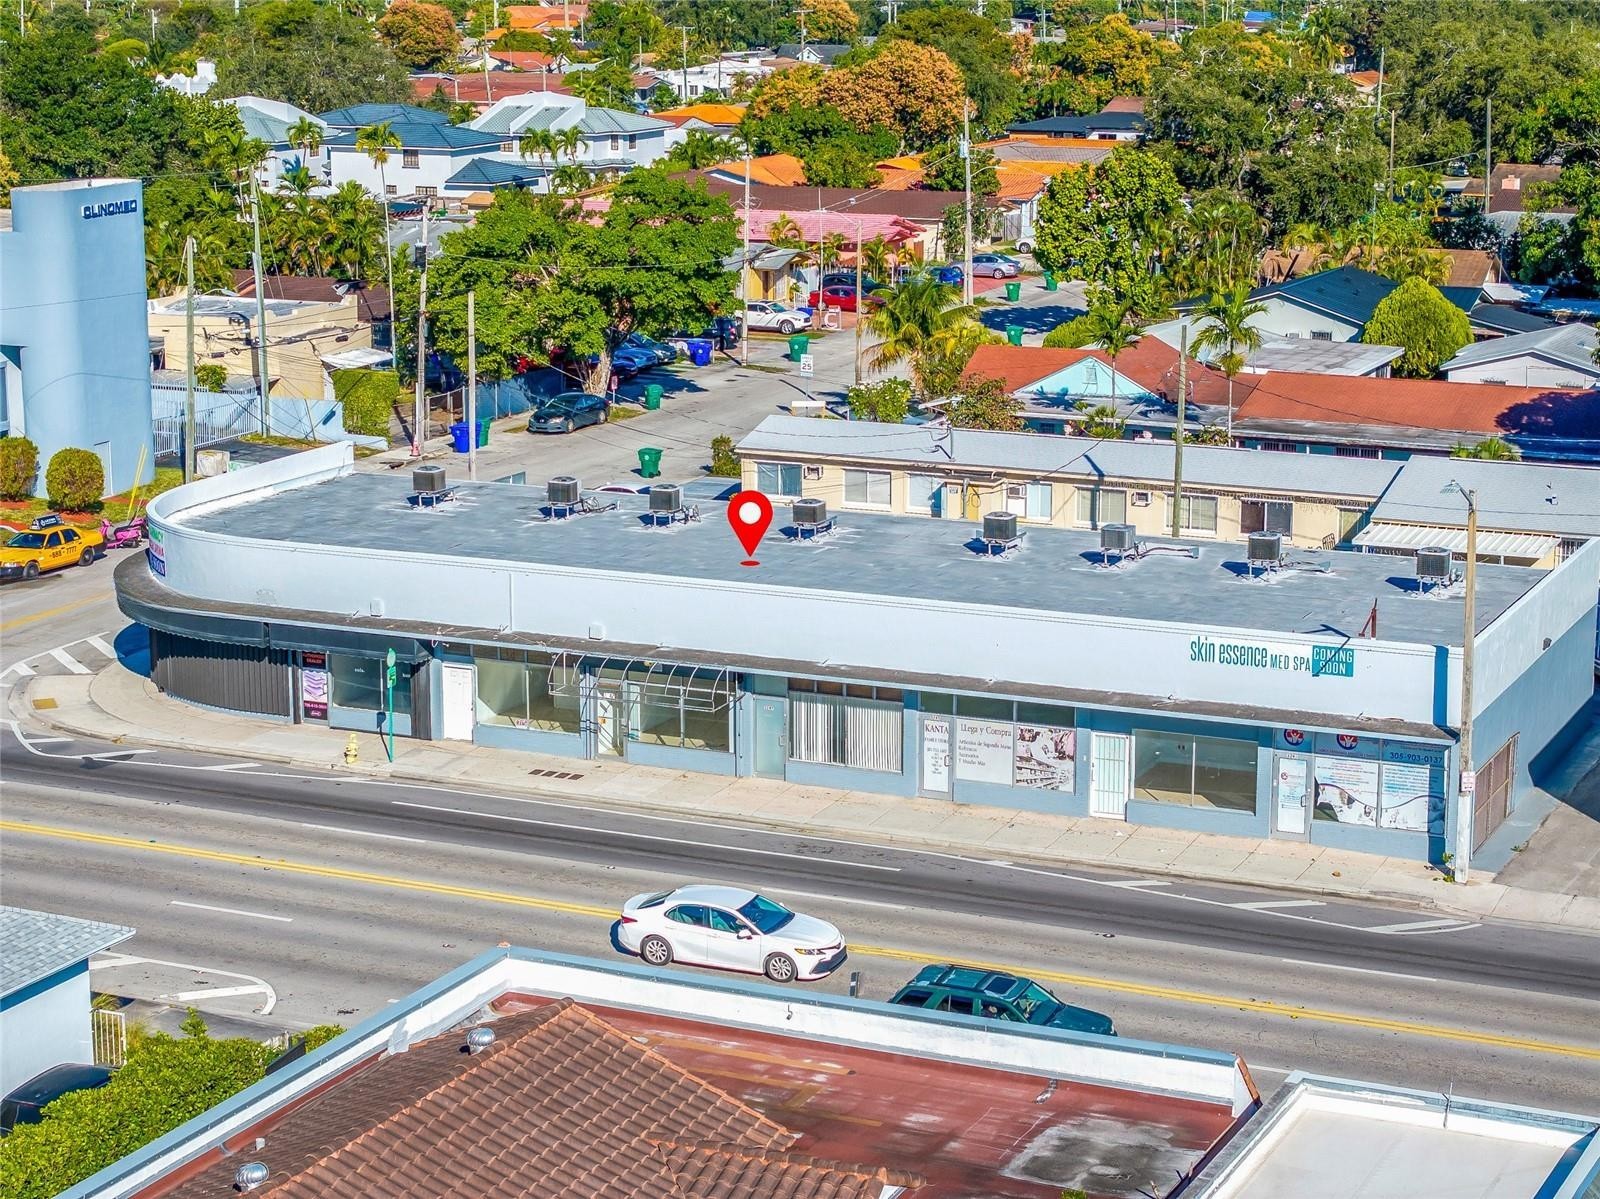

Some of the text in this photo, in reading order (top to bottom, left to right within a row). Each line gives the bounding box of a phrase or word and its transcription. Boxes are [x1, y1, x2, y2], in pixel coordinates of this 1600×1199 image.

[802, 362, 812, 370] 25
[1190, 636, 1311, 672] skin essence MED SPA
[1313, 648, 1352, 663] COMING
[1320, 660, 1346, 675] SOON
[925, 723, 949, 735] KANTA
[986, 726, 1012, 739] Compra
[1390, 752, 1443, 764] 305-903-0137
